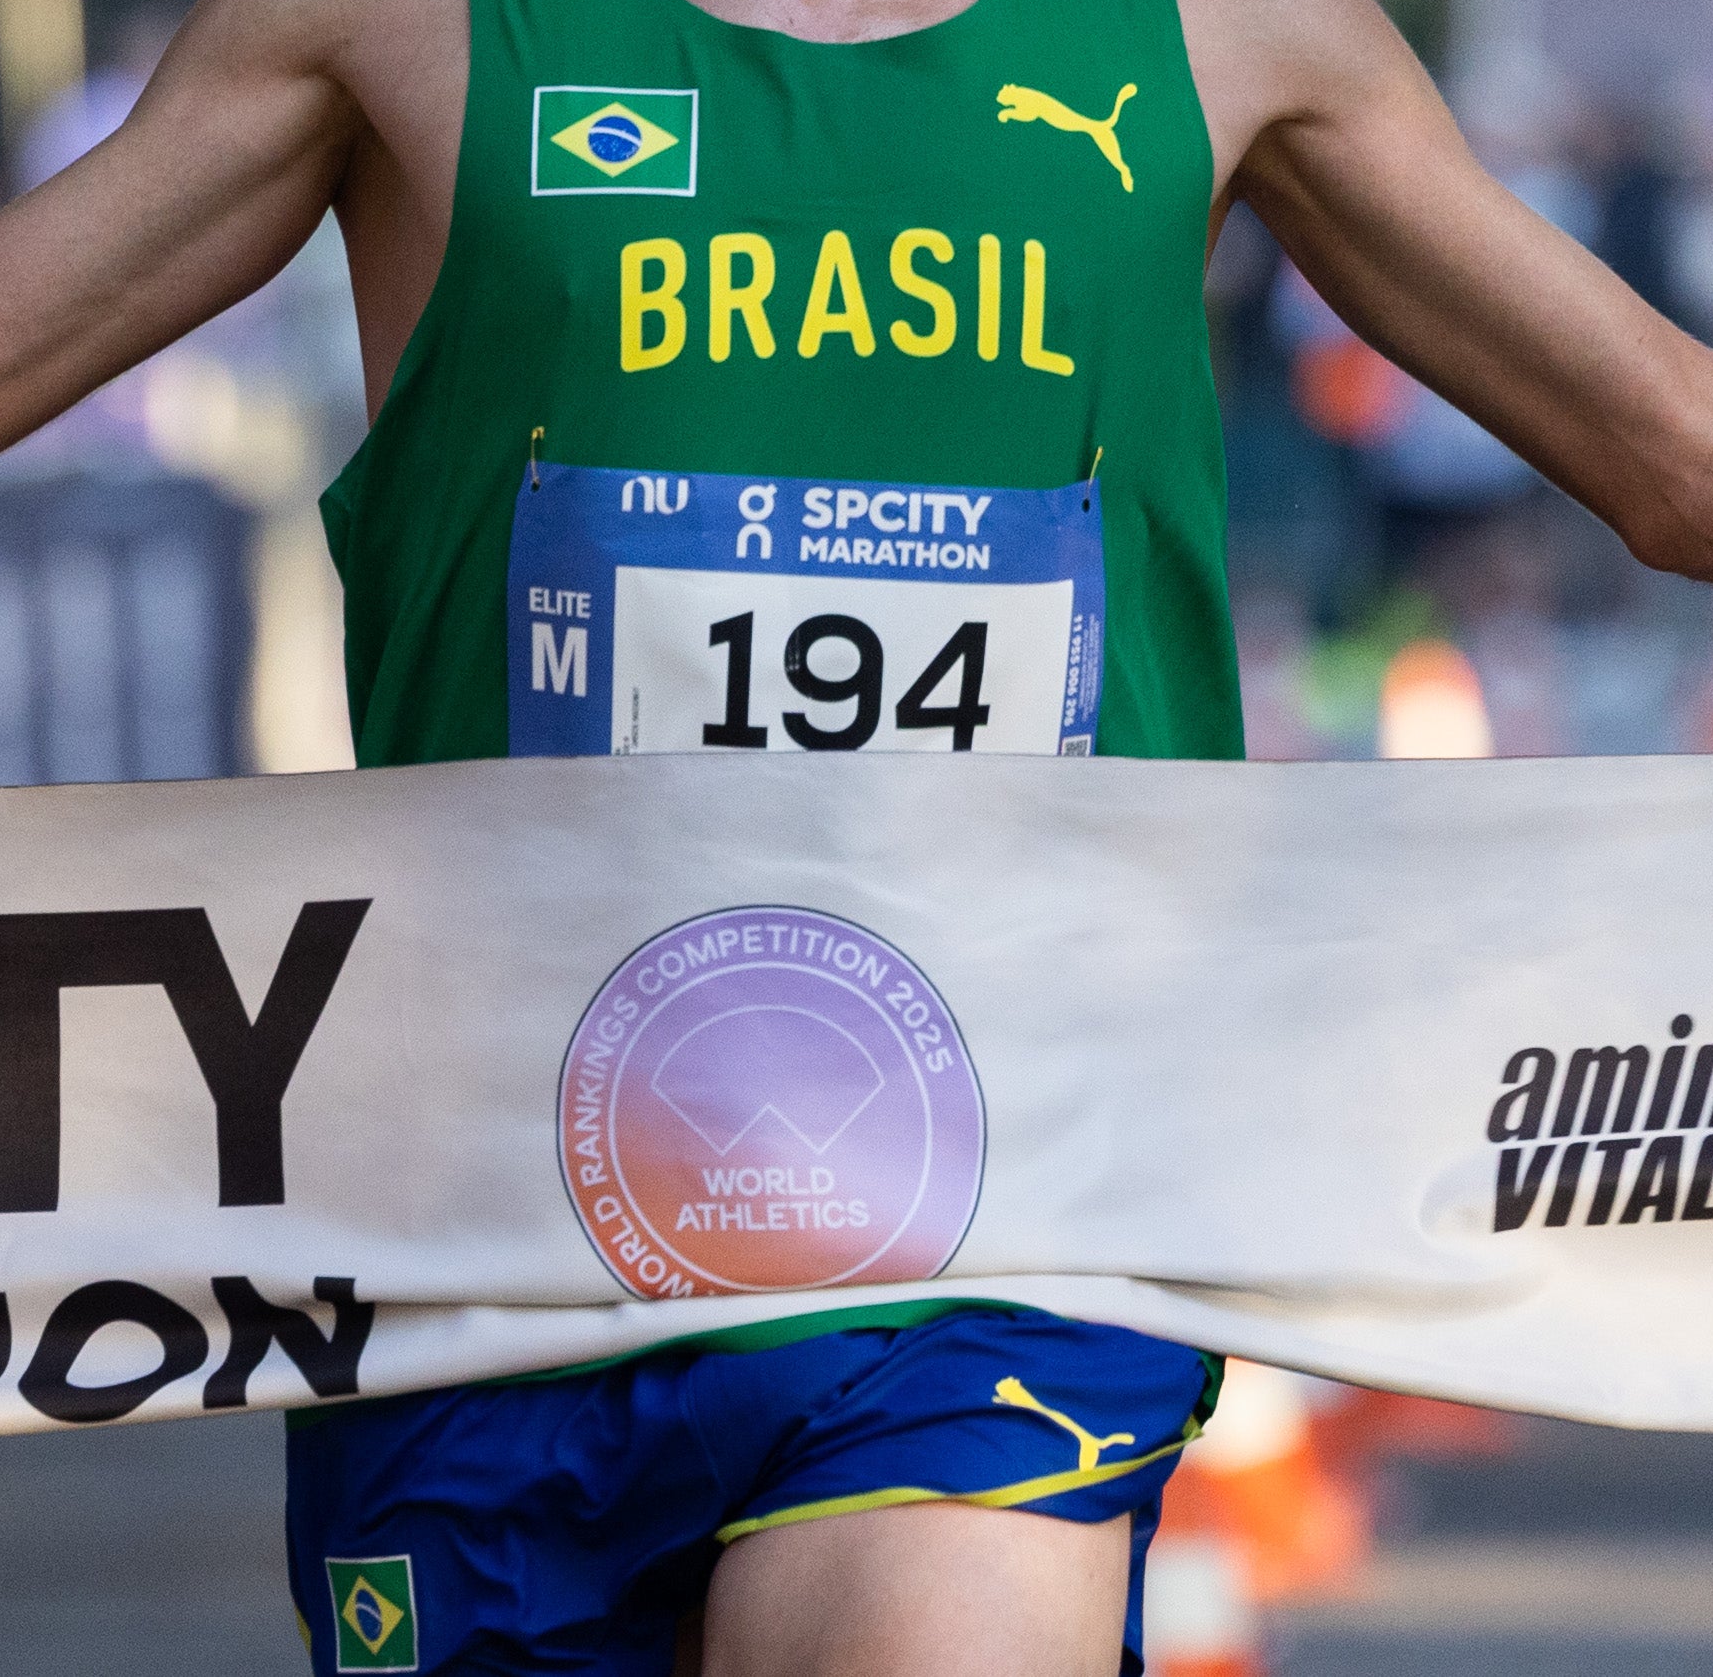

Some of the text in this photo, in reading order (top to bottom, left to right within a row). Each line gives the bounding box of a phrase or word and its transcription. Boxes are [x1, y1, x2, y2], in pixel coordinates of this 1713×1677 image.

[619, 227, 1076, 376] BRASIL
[802, 487, 992, 536] SPCITY
[799, 535, 990, 571] MARATHON
[529, 586, 592, 620] ELITE
[532, 622, 588, 697] M
[701, 610, 991, 753] 194
[573, 923, 955, 1299] WORLD RANKINGS COMPETITION 2025
[702, 1166, 836, 1197] WORLD
[675, 1200, 871, 1232] ATHLETICS
